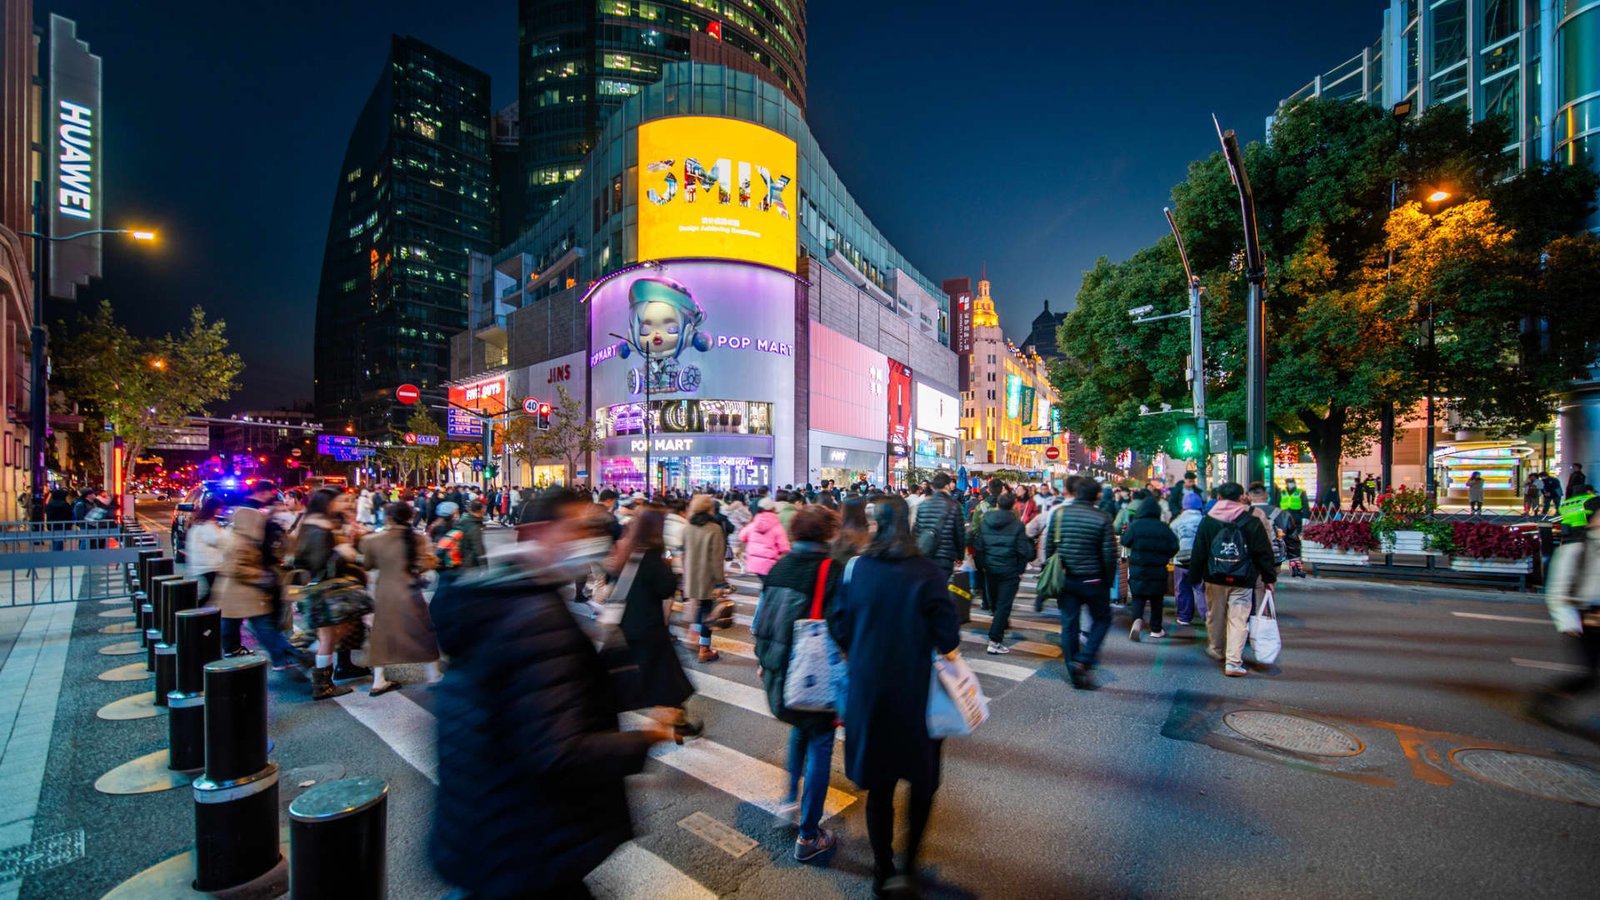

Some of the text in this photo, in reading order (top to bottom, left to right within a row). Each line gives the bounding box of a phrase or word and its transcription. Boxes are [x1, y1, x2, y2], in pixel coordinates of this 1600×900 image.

[59, 100, 92, 220] HUAWEI
[598, 344, 617, 361] MART
[717, 335, 793, 357] POP MART
[547, 364, 571, 384] JINS
[526, 402, 537, 411] 40
[631, 439, 693, 452] POP MART
